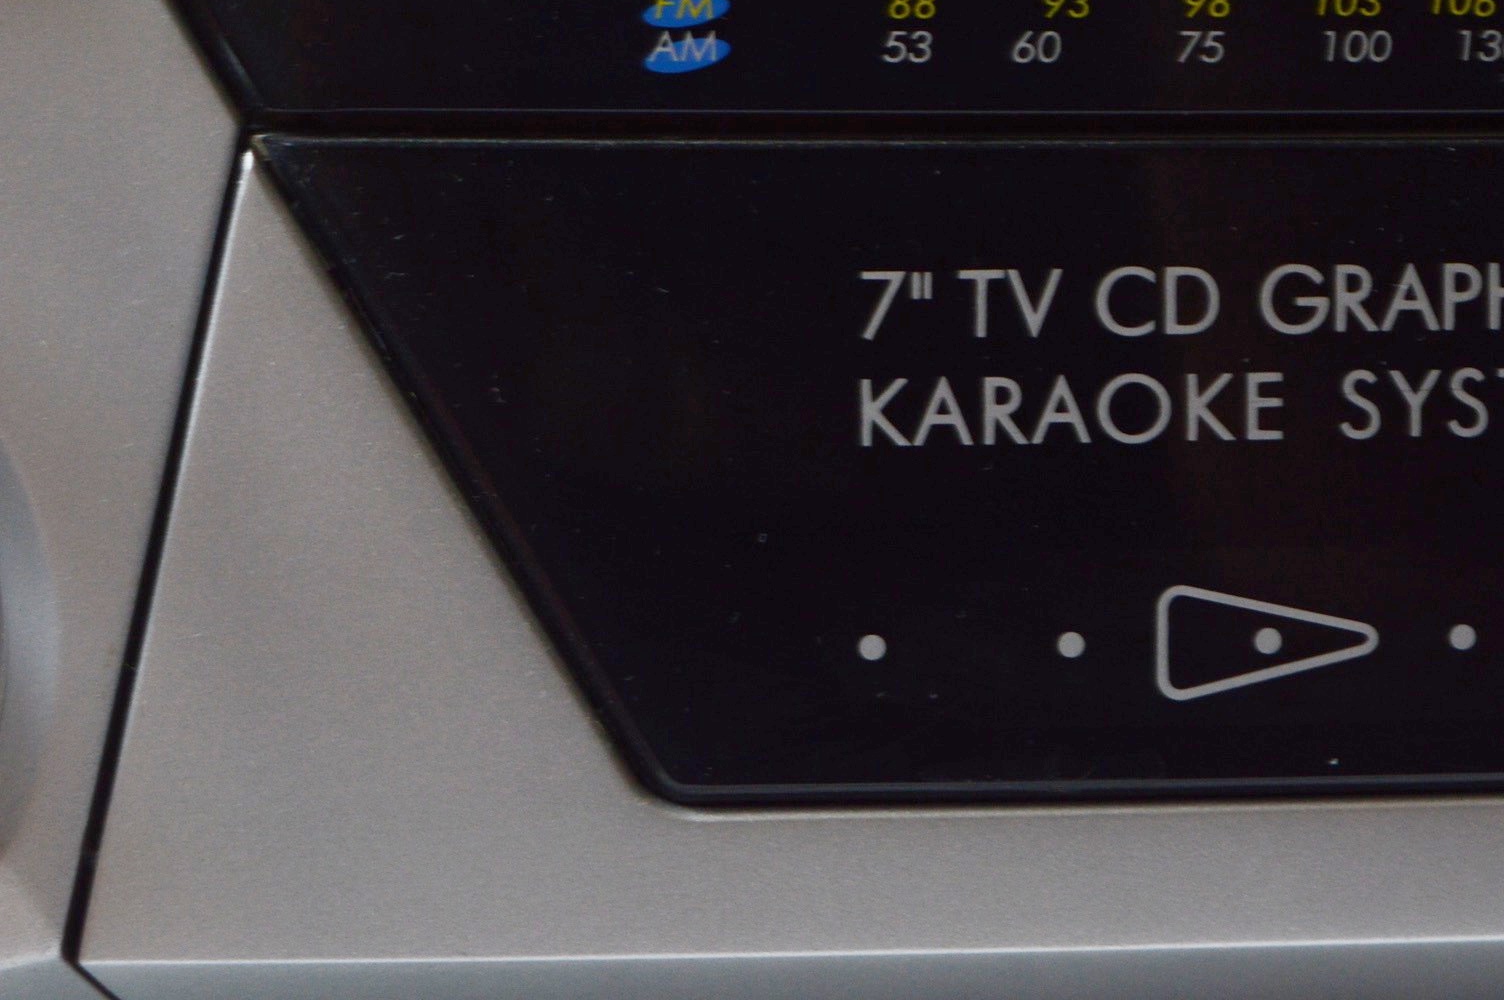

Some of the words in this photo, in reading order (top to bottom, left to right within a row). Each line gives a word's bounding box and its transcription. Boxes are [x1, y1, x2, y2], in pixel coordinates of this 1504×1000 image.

[648, 30, 717, 62] AM
[882, 30, 933, 64] 53
[1011, 30, 1062, 64] 60
[1178, 30, 1225, 64] 75
[1324, 29, 1393, 63] 100
[957, 268, 1063, 338] TV
[1095, 265, 1220, 337] CD
[860, 371, 1284, 447] KARAOKE
